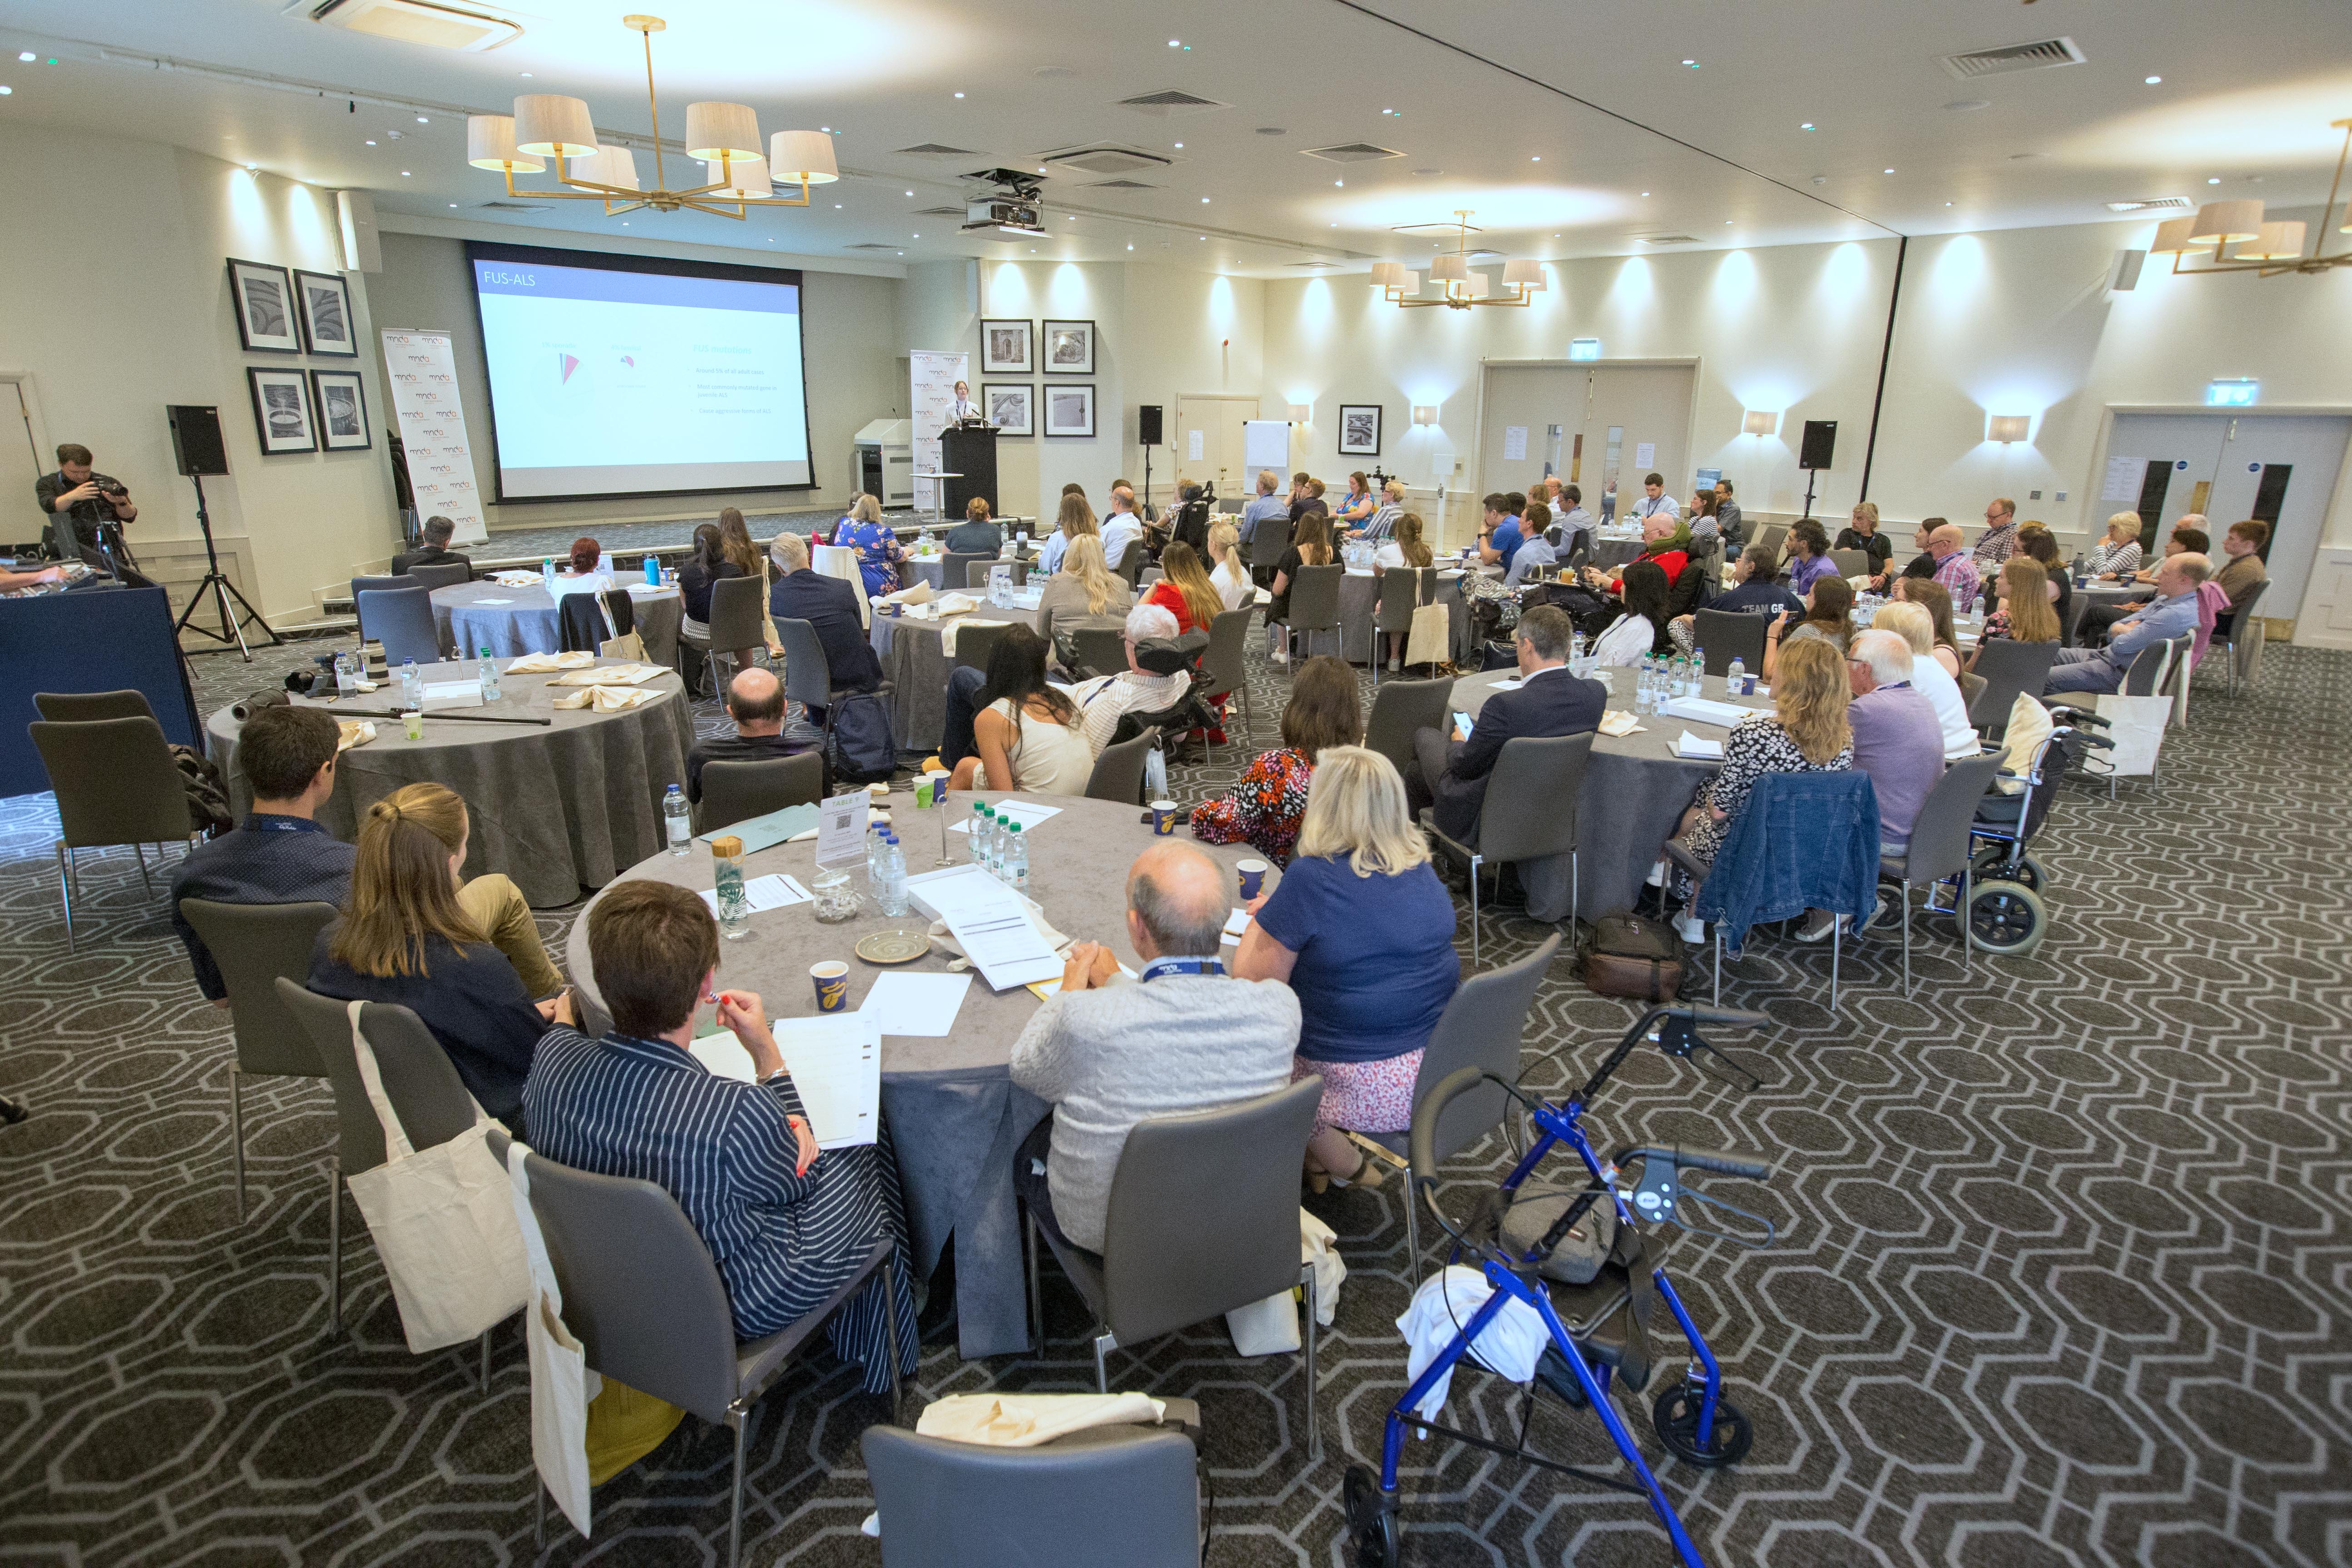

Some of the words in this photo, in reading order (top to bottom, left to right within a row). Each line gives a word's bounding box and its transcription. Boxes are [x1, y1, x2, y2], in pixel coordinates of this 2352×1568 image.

[484, 271, 535, 286] FUS-ALS
[387, 335, 409, 343] mnda
[693, 344, 709, 353] FUS
[711, 345, 752, 354] mutations
[408, 354, 430, 363] mnda
[417, 483, 438, 491] mnda
[457, 515, 476, 523] mnda
[1741, 604, 1769, 613] TEAM
[1771, 603, 1784, 613] GB
[832, 799, 853, 807] TABLE
